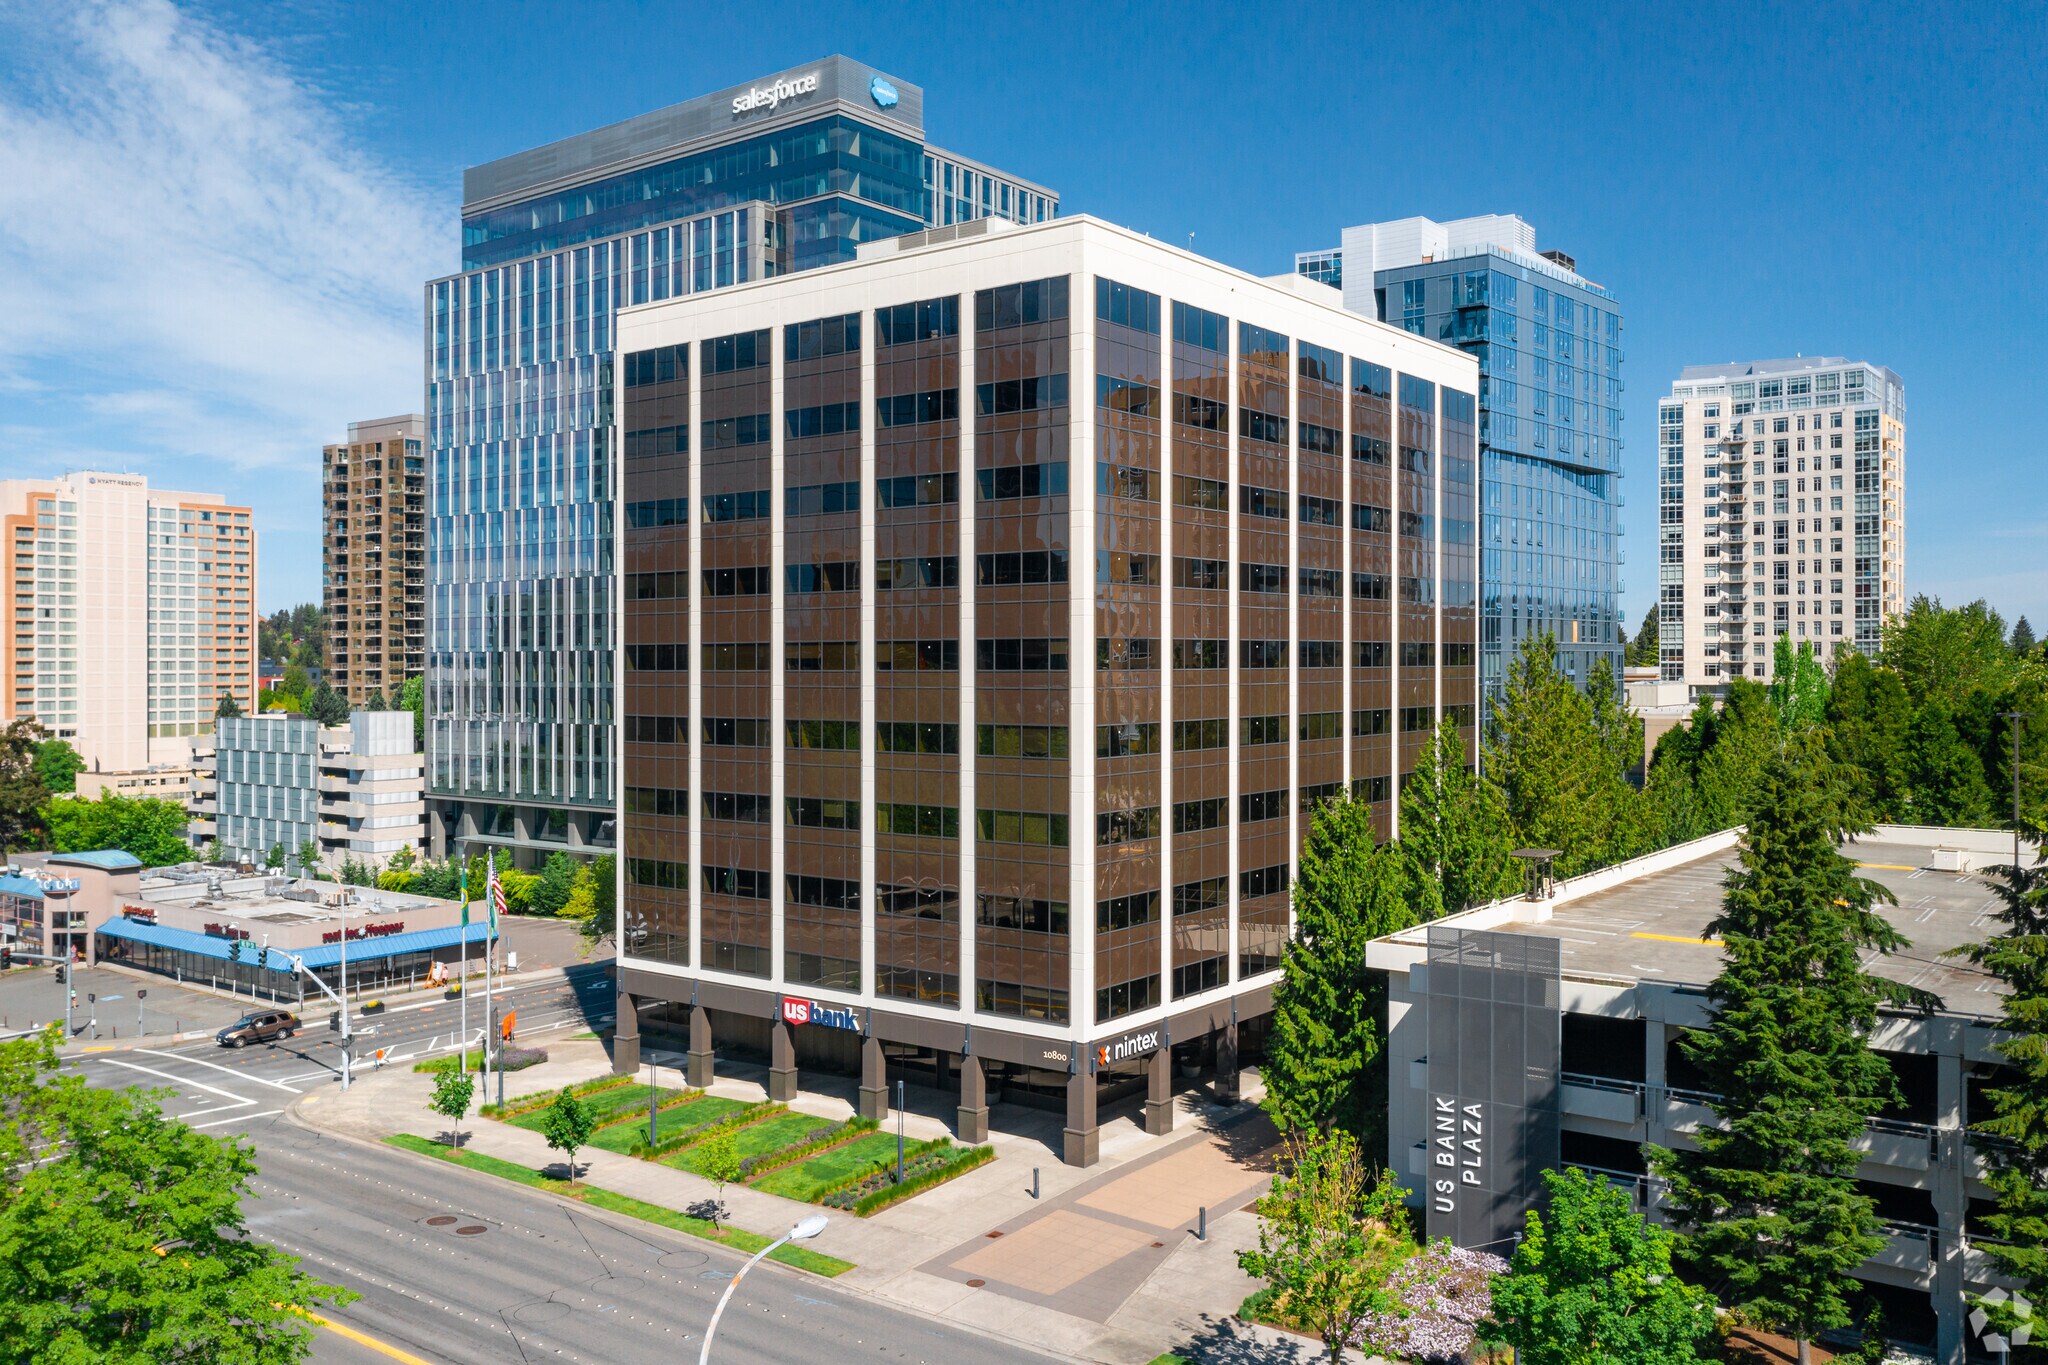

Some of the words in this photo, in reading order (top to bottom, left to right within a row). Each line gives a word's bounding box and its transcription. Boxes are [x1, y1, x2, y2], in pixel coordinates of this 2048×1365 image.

[732, 75, 816, 114] salesforce
[1043, 1050, 1067, 1061] 10800
[1114, 1031, 1158, 1060] nintex
[1436, 1097, 1455, 1167] BANK
[1462, 1103, 1482, 1185] PLAZA
[1435, 1179, 1455, 1212] US
